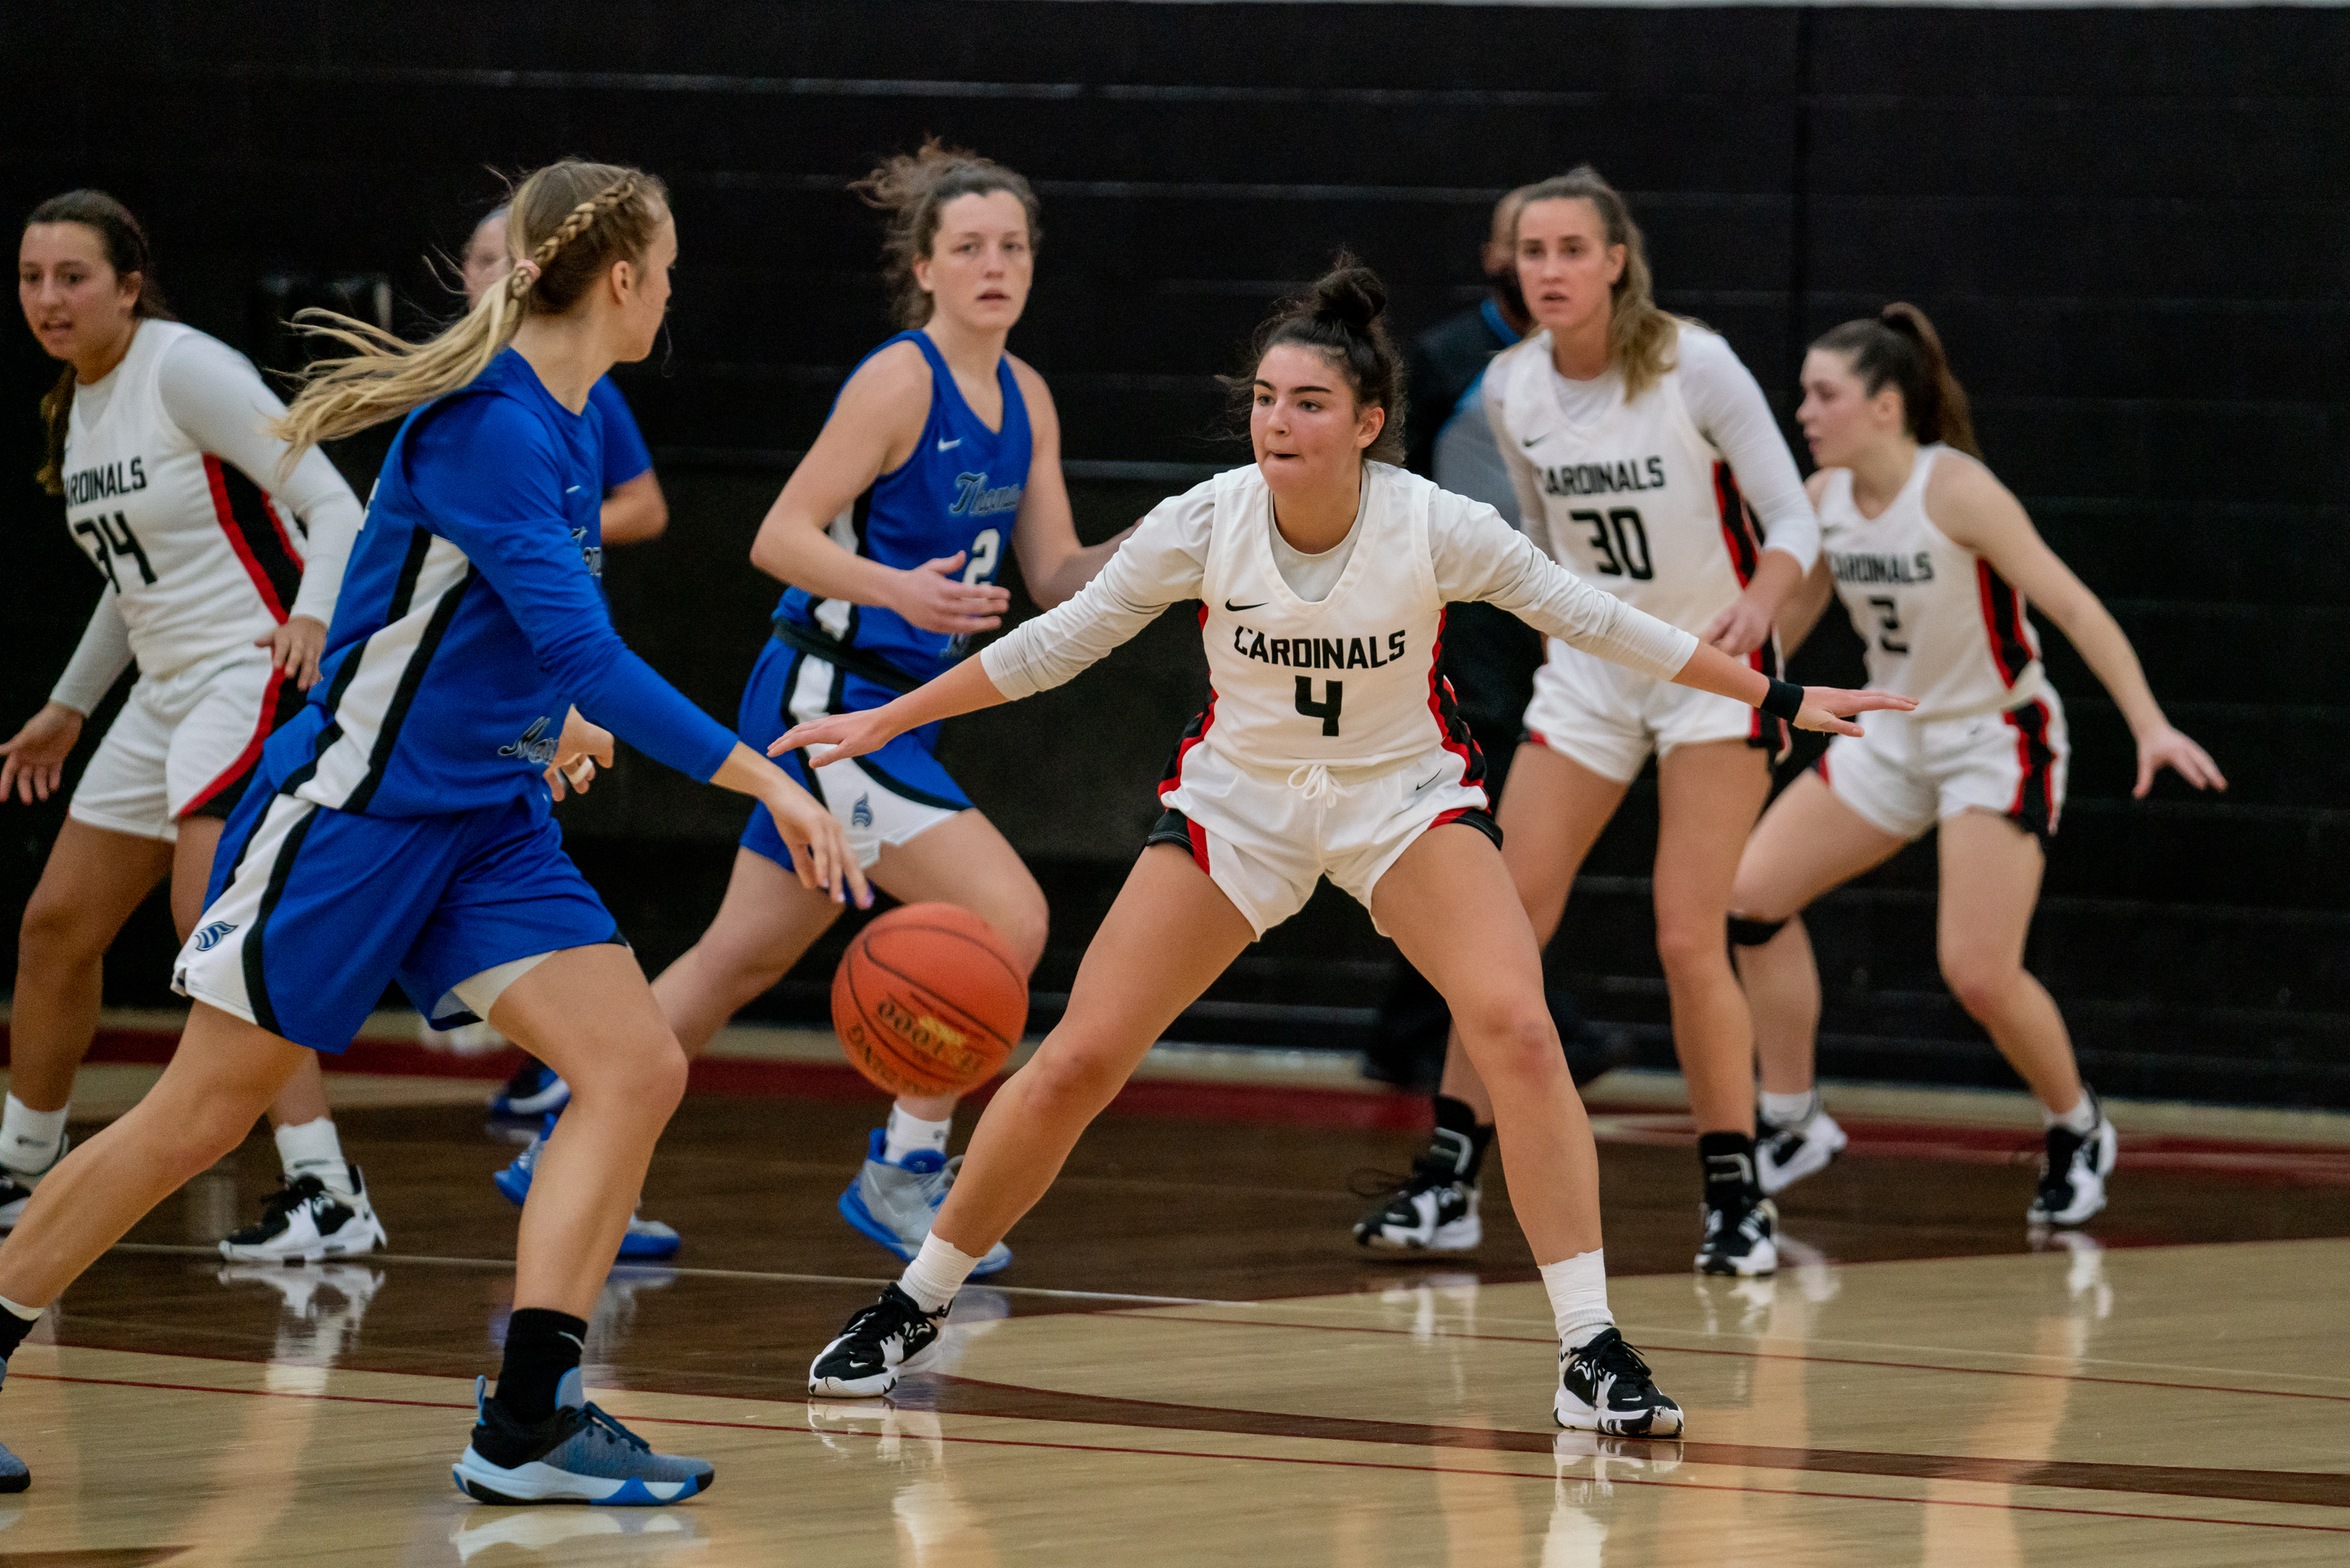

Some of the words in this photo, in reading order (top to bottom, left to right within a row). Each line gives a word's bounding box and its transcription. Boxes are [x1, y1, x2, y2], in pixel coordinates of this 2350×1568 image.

[65, 455, 147, 509] RDINALS
[1540, 455, 1665, 496] ARDINALS
[73, 510, 158, 595] 34
[962, 527, 1000, 601] 2
[1570, 507, 1653, 581] 30
[1234, 625, 1406, 669] CARDINALS
[1294, 674, 1343, 737] 4
